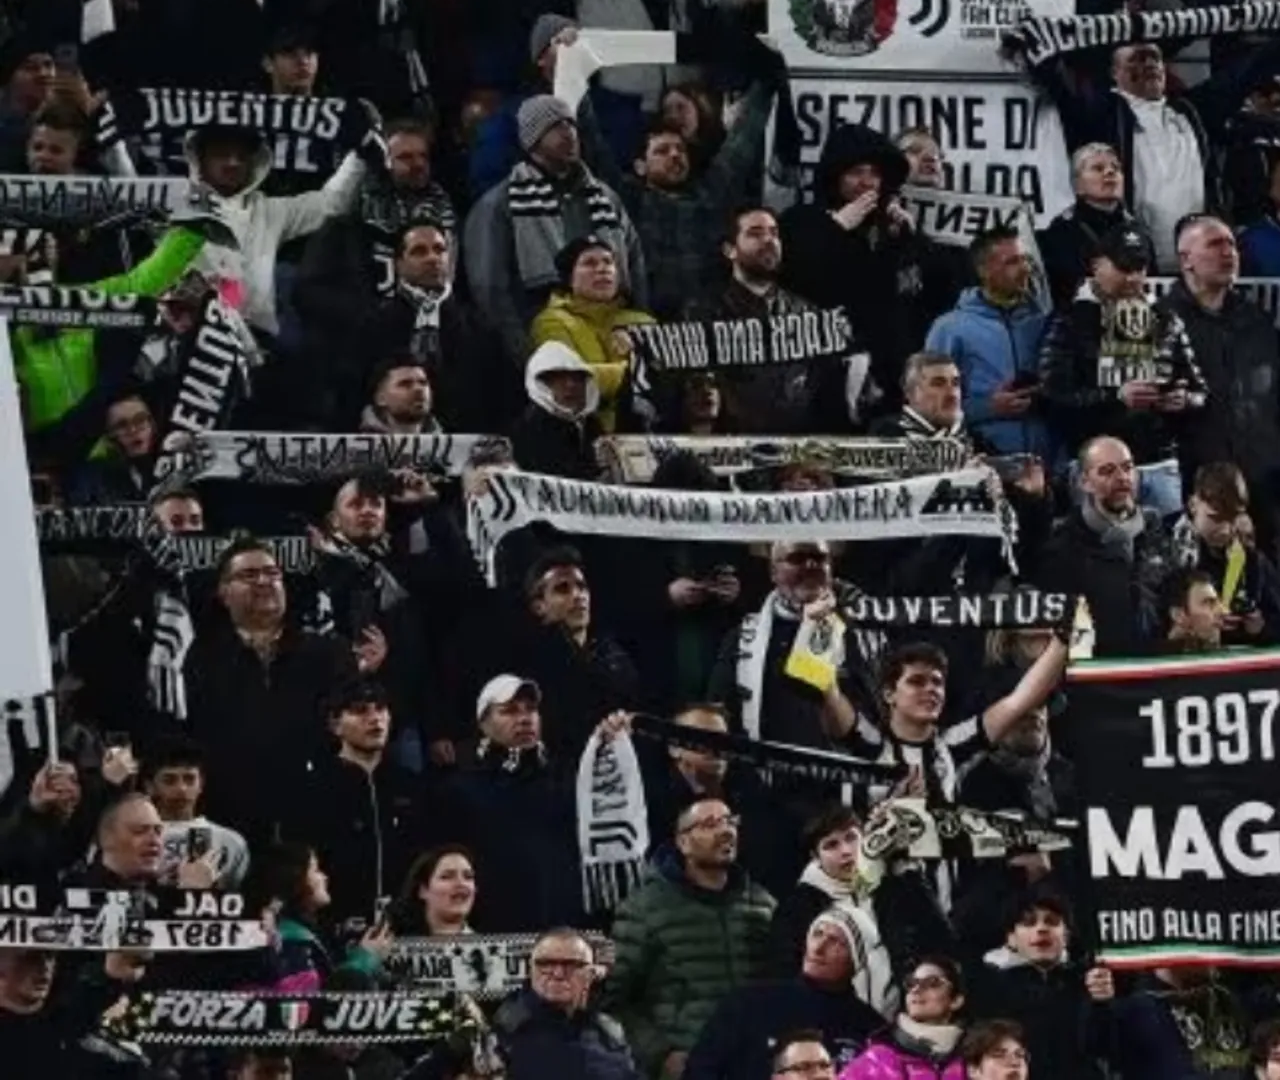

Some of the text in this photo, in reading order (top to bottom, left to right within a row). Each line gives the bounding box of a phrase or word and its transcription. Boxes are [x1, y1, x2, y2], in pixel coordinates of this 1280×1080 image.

[140, 87, 347, 139] JUVENTUS
[1004, 98, 1039, 150] DI
[845, 590, 1069, 627] JUVENTUS
[1098, 910, 1155, 943] FINO
[1162, 910, 1223, 943] ALLA
[150, 995, 425, 1032] FORZA JUVE
